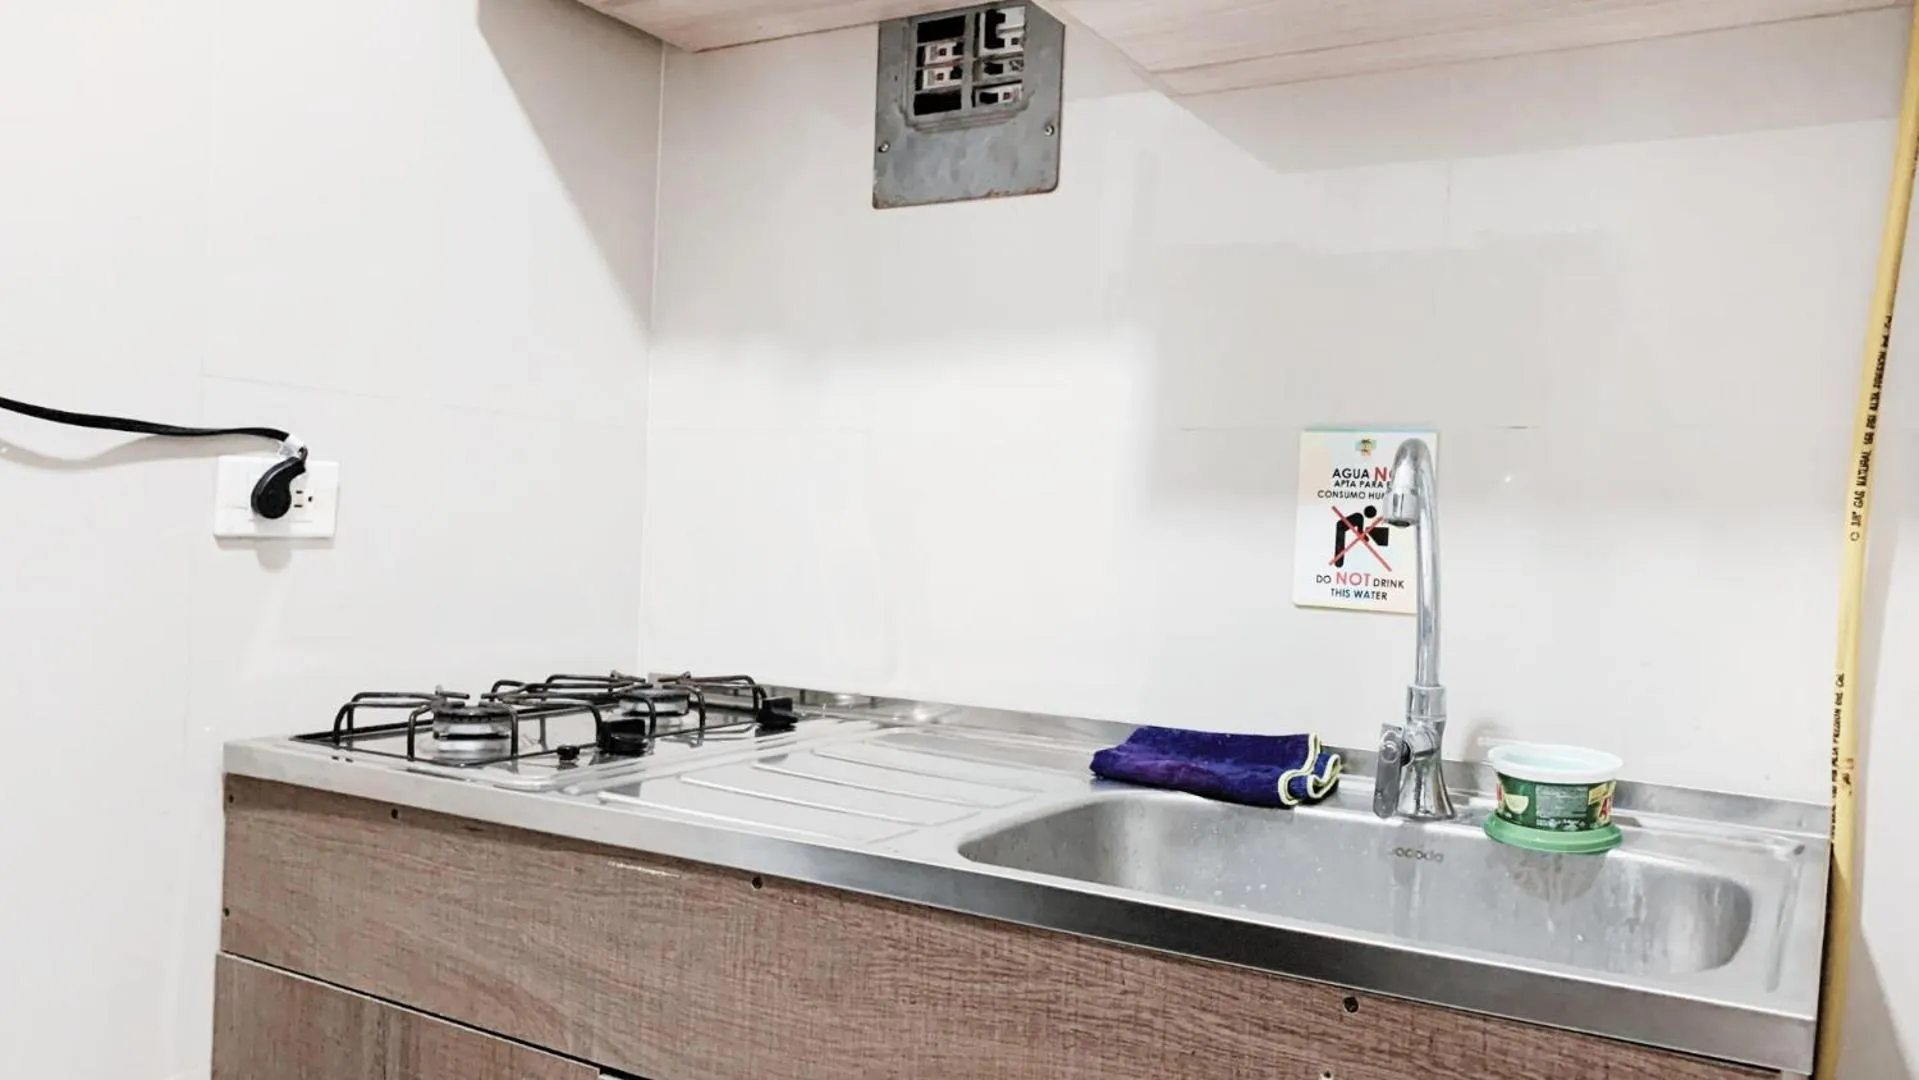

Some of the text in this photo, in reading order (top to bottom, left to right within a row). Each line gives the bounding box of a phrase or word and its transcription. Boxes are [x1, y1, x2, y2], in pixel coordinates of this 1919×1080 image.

[1332, 466, 1393, 482] AGUA N
[1856, 450, 1873, 487] NATURAL
[1334, 479, 1357, 488] APTA
[1359, 480, 1384, 489] PARA
[1317, 489, 1366, 500] CONSUMO
[1854, 491, 1866, 509] GAS
[1315, 571, 1405, 589] DO NOT DRINK
[1331, 588, 1388, 601] THIS WATER
